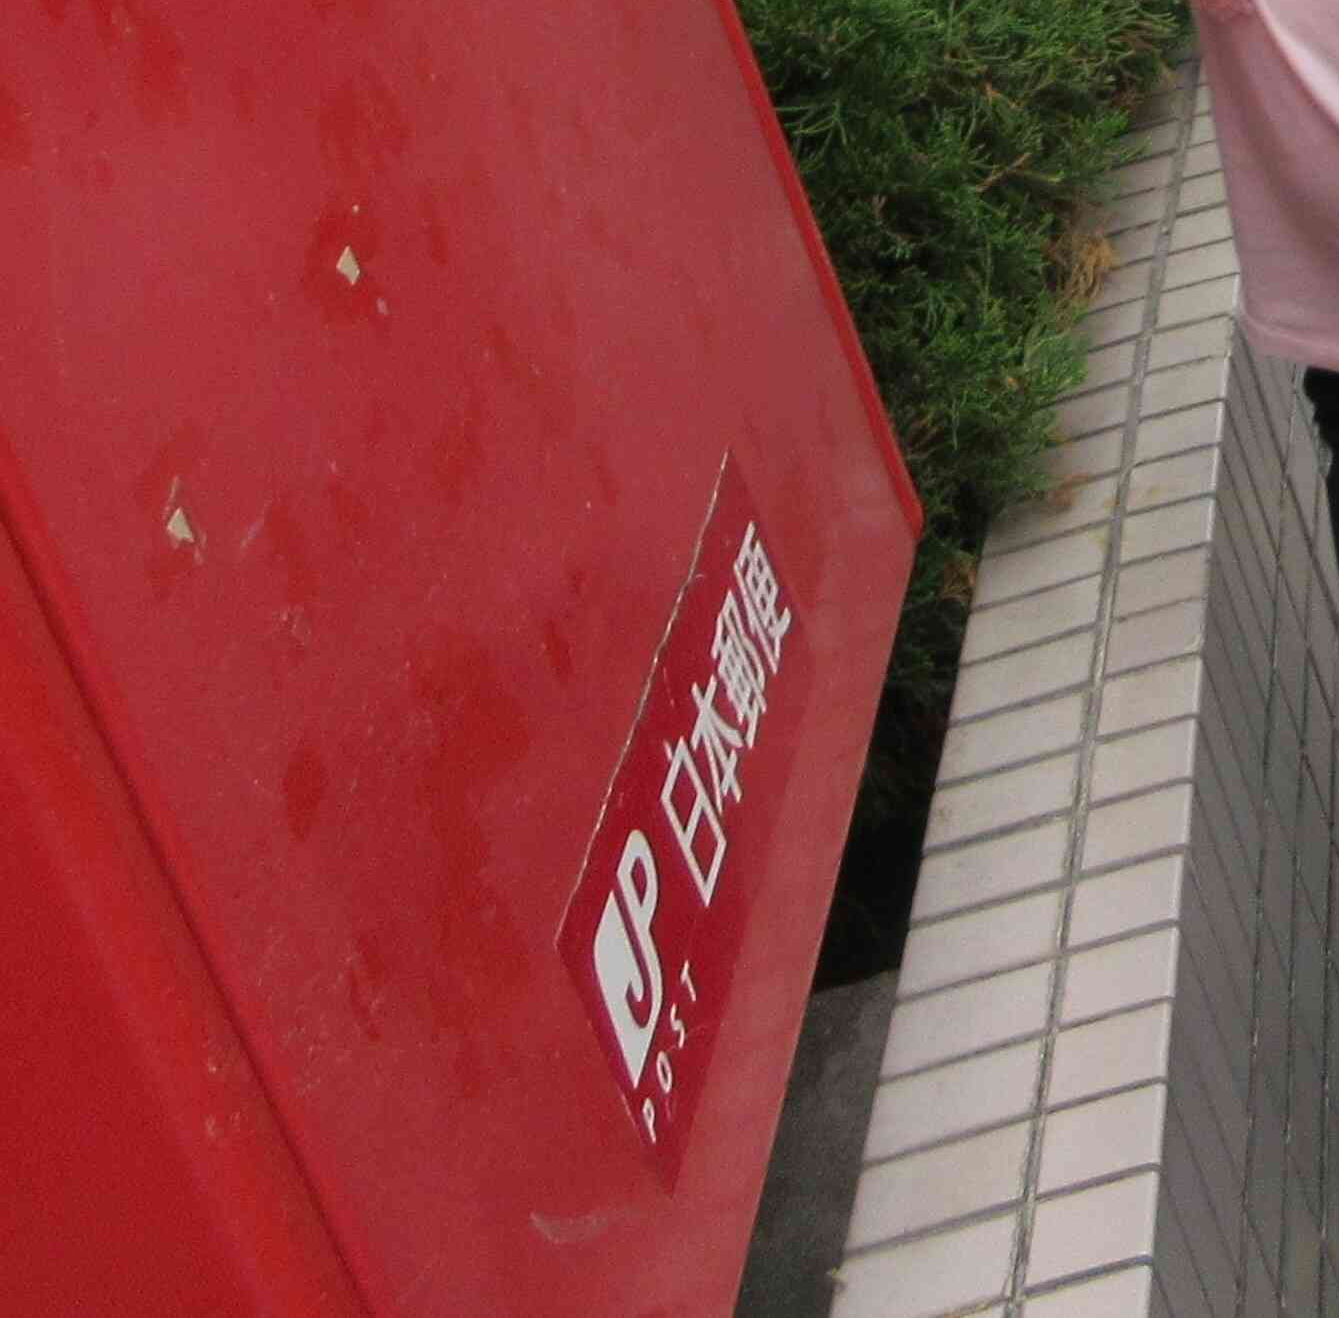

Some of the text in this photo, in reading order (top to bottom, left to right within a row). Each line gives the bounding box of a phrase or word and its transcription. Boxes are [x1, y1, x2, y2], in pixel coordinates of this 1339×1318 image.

[660, 521, 792, 907] 日本郵便
[641, 961, 699, 1143] POST
